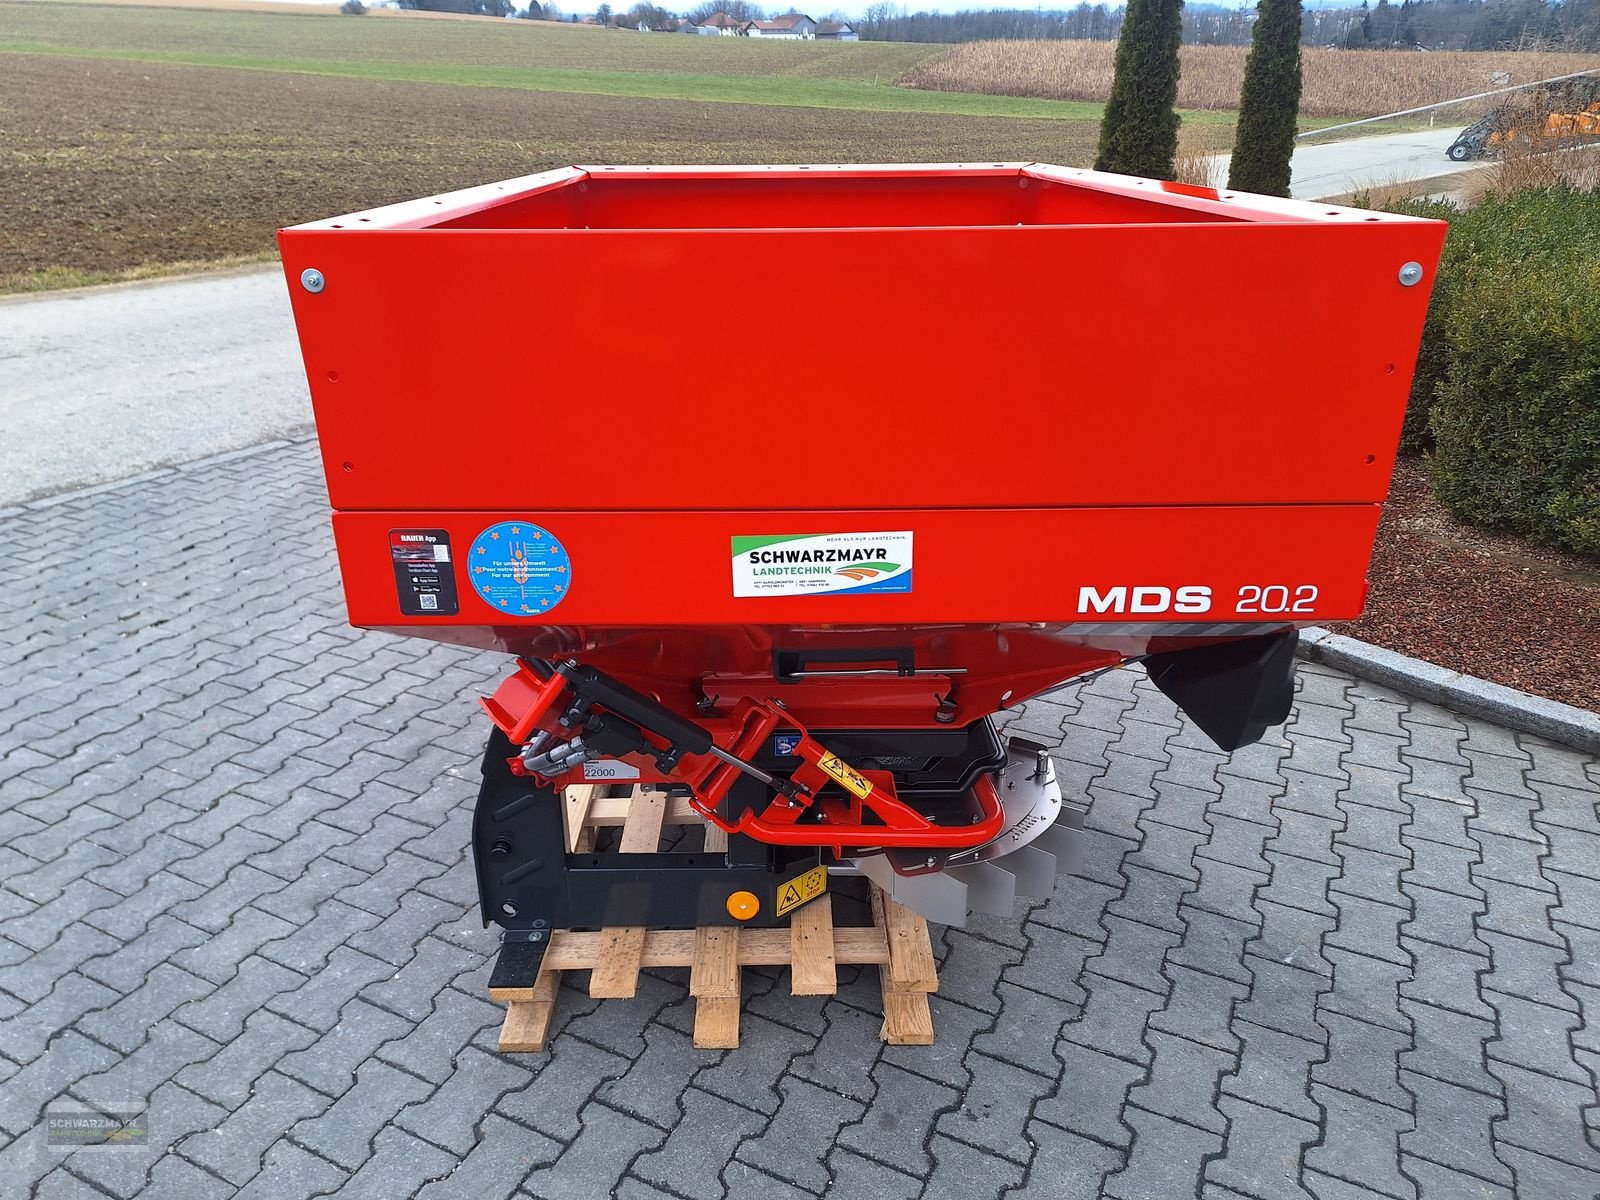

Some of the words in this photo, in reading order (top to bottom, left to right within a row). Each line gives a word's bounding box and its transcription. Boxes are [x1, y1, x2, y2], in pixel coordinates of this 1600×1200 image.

[424, 535, 436, 543] App
[750, 548, 887, 564] SCHWARZMAYR
[752, 566, 832, 576] LANDTECHNIK
[1077, 585, 1213, 613] MDS
[1235, 585, 1319, 613] 20.2
[585, 768, 616, 777] 22000
[806, 887, 821, 897] STOP
